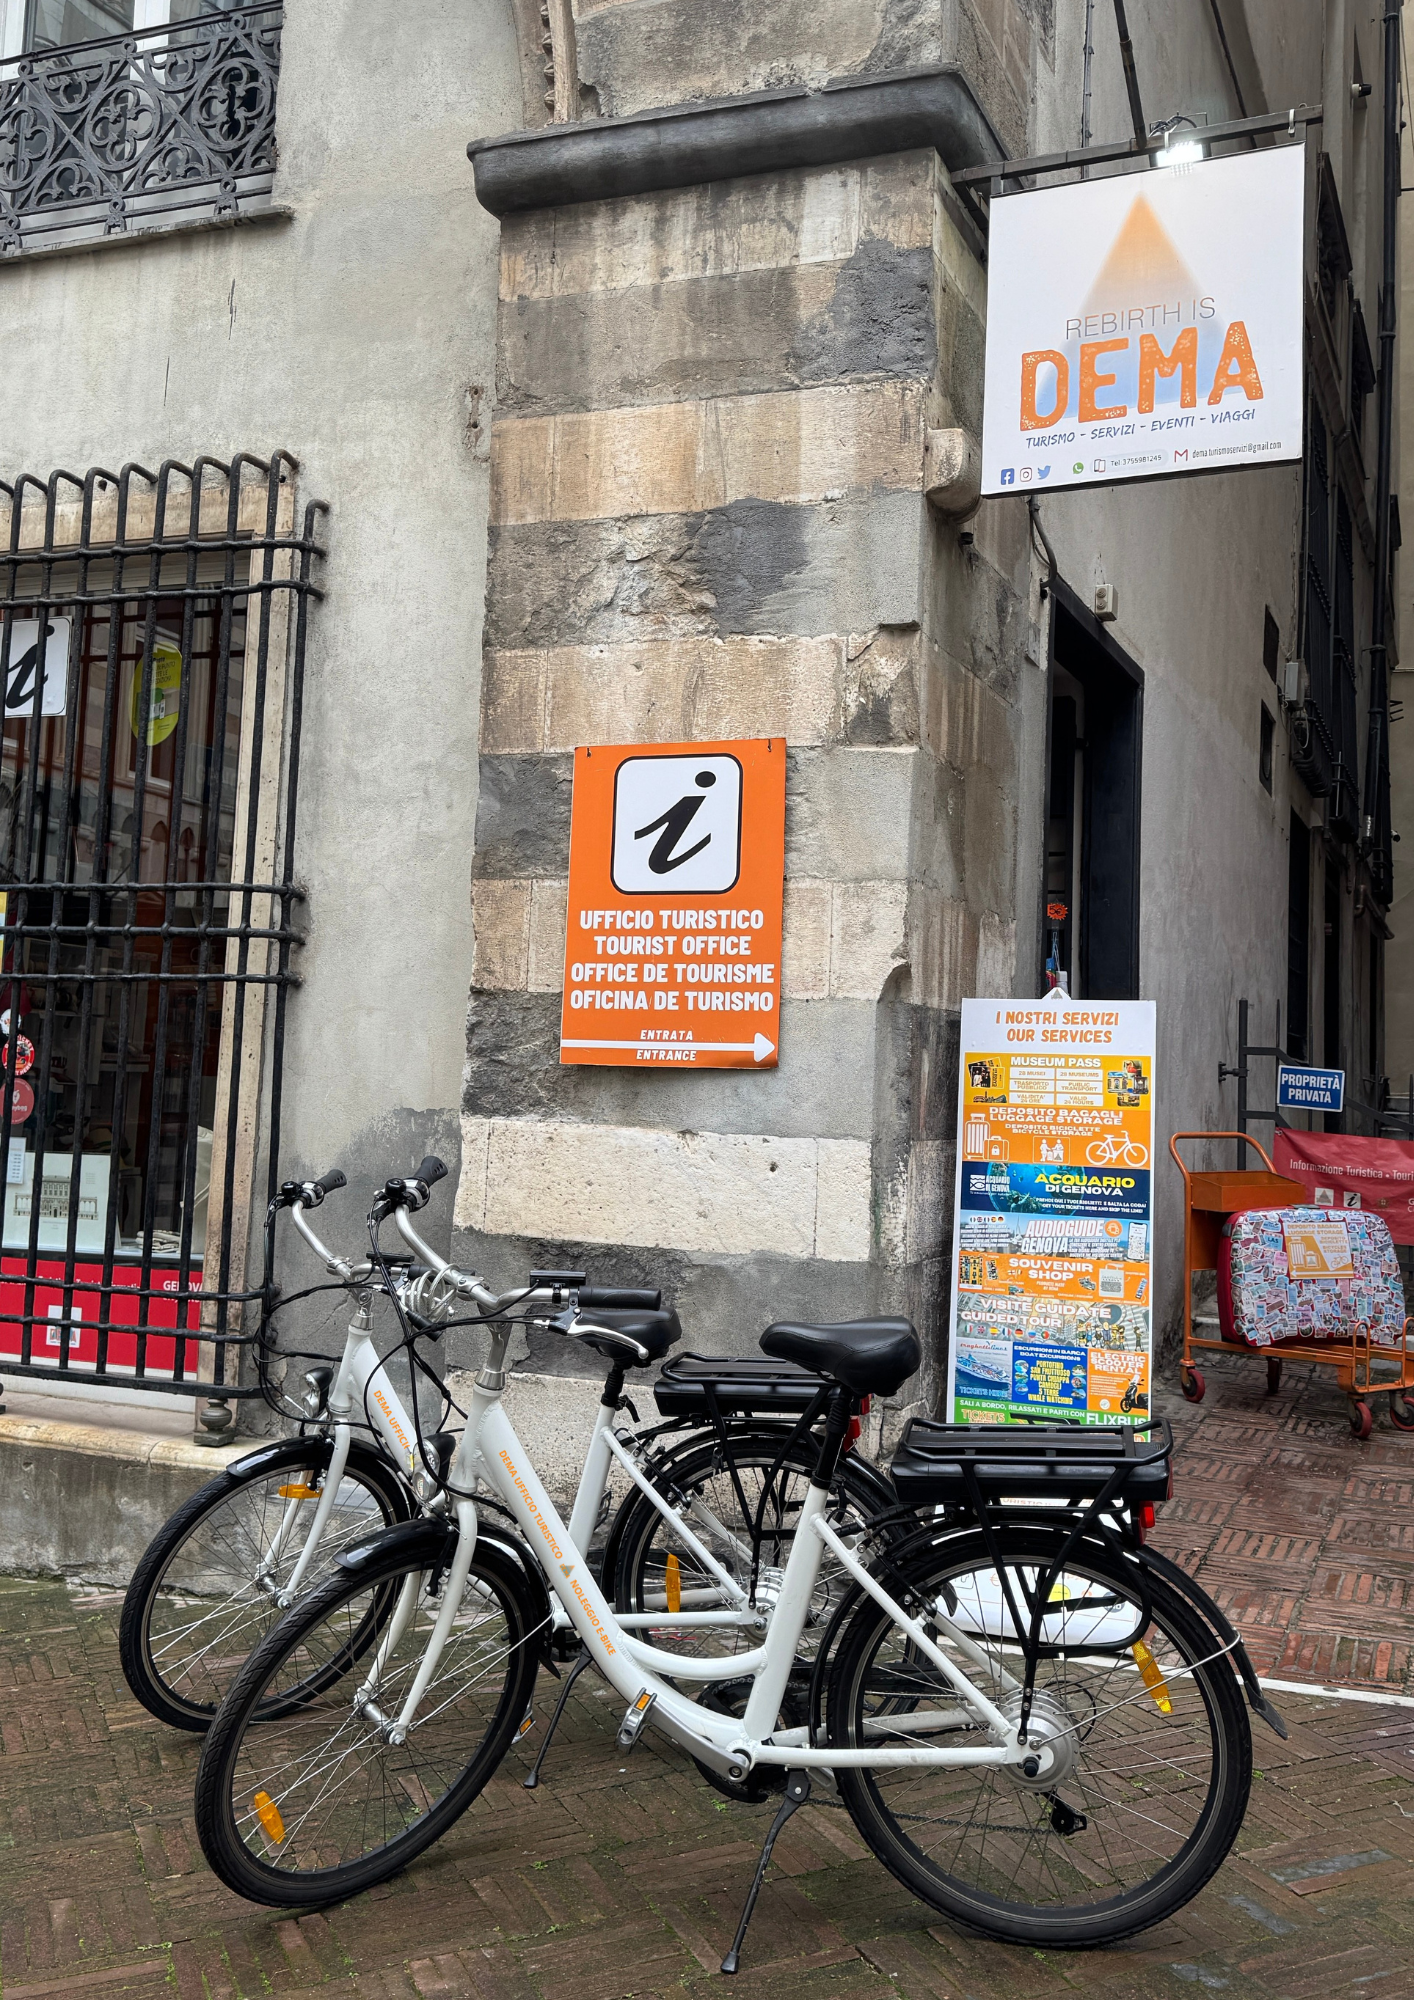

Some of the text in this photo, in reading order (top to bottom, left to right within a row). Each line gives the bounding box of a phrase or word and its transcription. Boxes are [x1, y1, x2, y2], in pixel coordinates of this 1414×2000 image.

[1066, 297, 1216, 340] REBIRTH IS
[1020, 320, 1264, 431] DEMA
[1026, 432, 1076, 449] TURISMO
[1090, 423, 1136, 440] SERVIZI
[1150, 415, 1195, 431] EVENTI
[1211, 408, 1256, 424] VIAGGI
[579, 909, 764, 930] UFFICIO TURISTICO
[593, 935, 752, 956] TOURIST OFFICE
[571, 962, 775, 984] OFFICE DE TOURISME
[570, 990, 774, 1012] OFICINA DE TURISMO
[996, 1010, 1119, 1026] I NOSTRI SERVIZI
[639, 1029, 694, 1041] ENTRATA
[1007, 1028, 1113, 1044] OUR SERVICES
[636, 1050, 697, 1061] ENTRANCE
[1011, 1056, 1102, 1068] MUSEUM PASS
[1281, 1073, 1341, 1090] PROPRIETÀ
[1288, 1087, 1332, 1104] PRIVATA
[989, 1107, 1123, 1118] DEPOSITO BAGAGLI
[989, 1114, 1122, 1126] LUGGAGE STORAGE
[1050, 1125, 1101, 1133] BICICLETTE
[1290, 1158, 1343, 1175] Informazione
[1345, 1166, 1383, 1179] Turistica
[1034, 1173, 1136, 1188] ACQUARIO
[1045, 1184, 1060, 1193] DI
[1061, 1185, 1124, 1196] GENOVA
[1026, 1219, 1105, 1237] AUDIOGUIDE
[1020, 1237, 1070, 1254] GENOVA
[1008, 1258, 1094, 1273] SOUVENIR
[1028, 1269, 1074, 1281] SHOP
[981, 1299, 1112, 1319] VISITE GUIDATE
[960, 1310, 1062, 1328] GUIDED TOUR
[1014, 1345, 1052, 1354] ESCURSIONI
[1039, 1353, 1081, 1362] EXCURSIONS
[1090, 1351, 1146, 1363] ELECTRIC
[1036, 1360, 1064, 1370] PORTOFINO
[1091, 1358, 1145, 1369] SCOOTER
[1094, 1364, 1142, 1375] RENTAL
[373, 1389, 392, 1418] DEMA
[959, 1399, 974, 1407] SALI
[982, 1401, 1007, 1410] BORDO,
[1008, 1404, 1043, 1414] RILASSATI
[961, 1408, 1005, 1423] TICKETS
[499, 1449, 563, 1560] DEMA UFFICIO TURISTICO
[570, 1579, 617, 1657] NOLEGGIO E-BIKE
